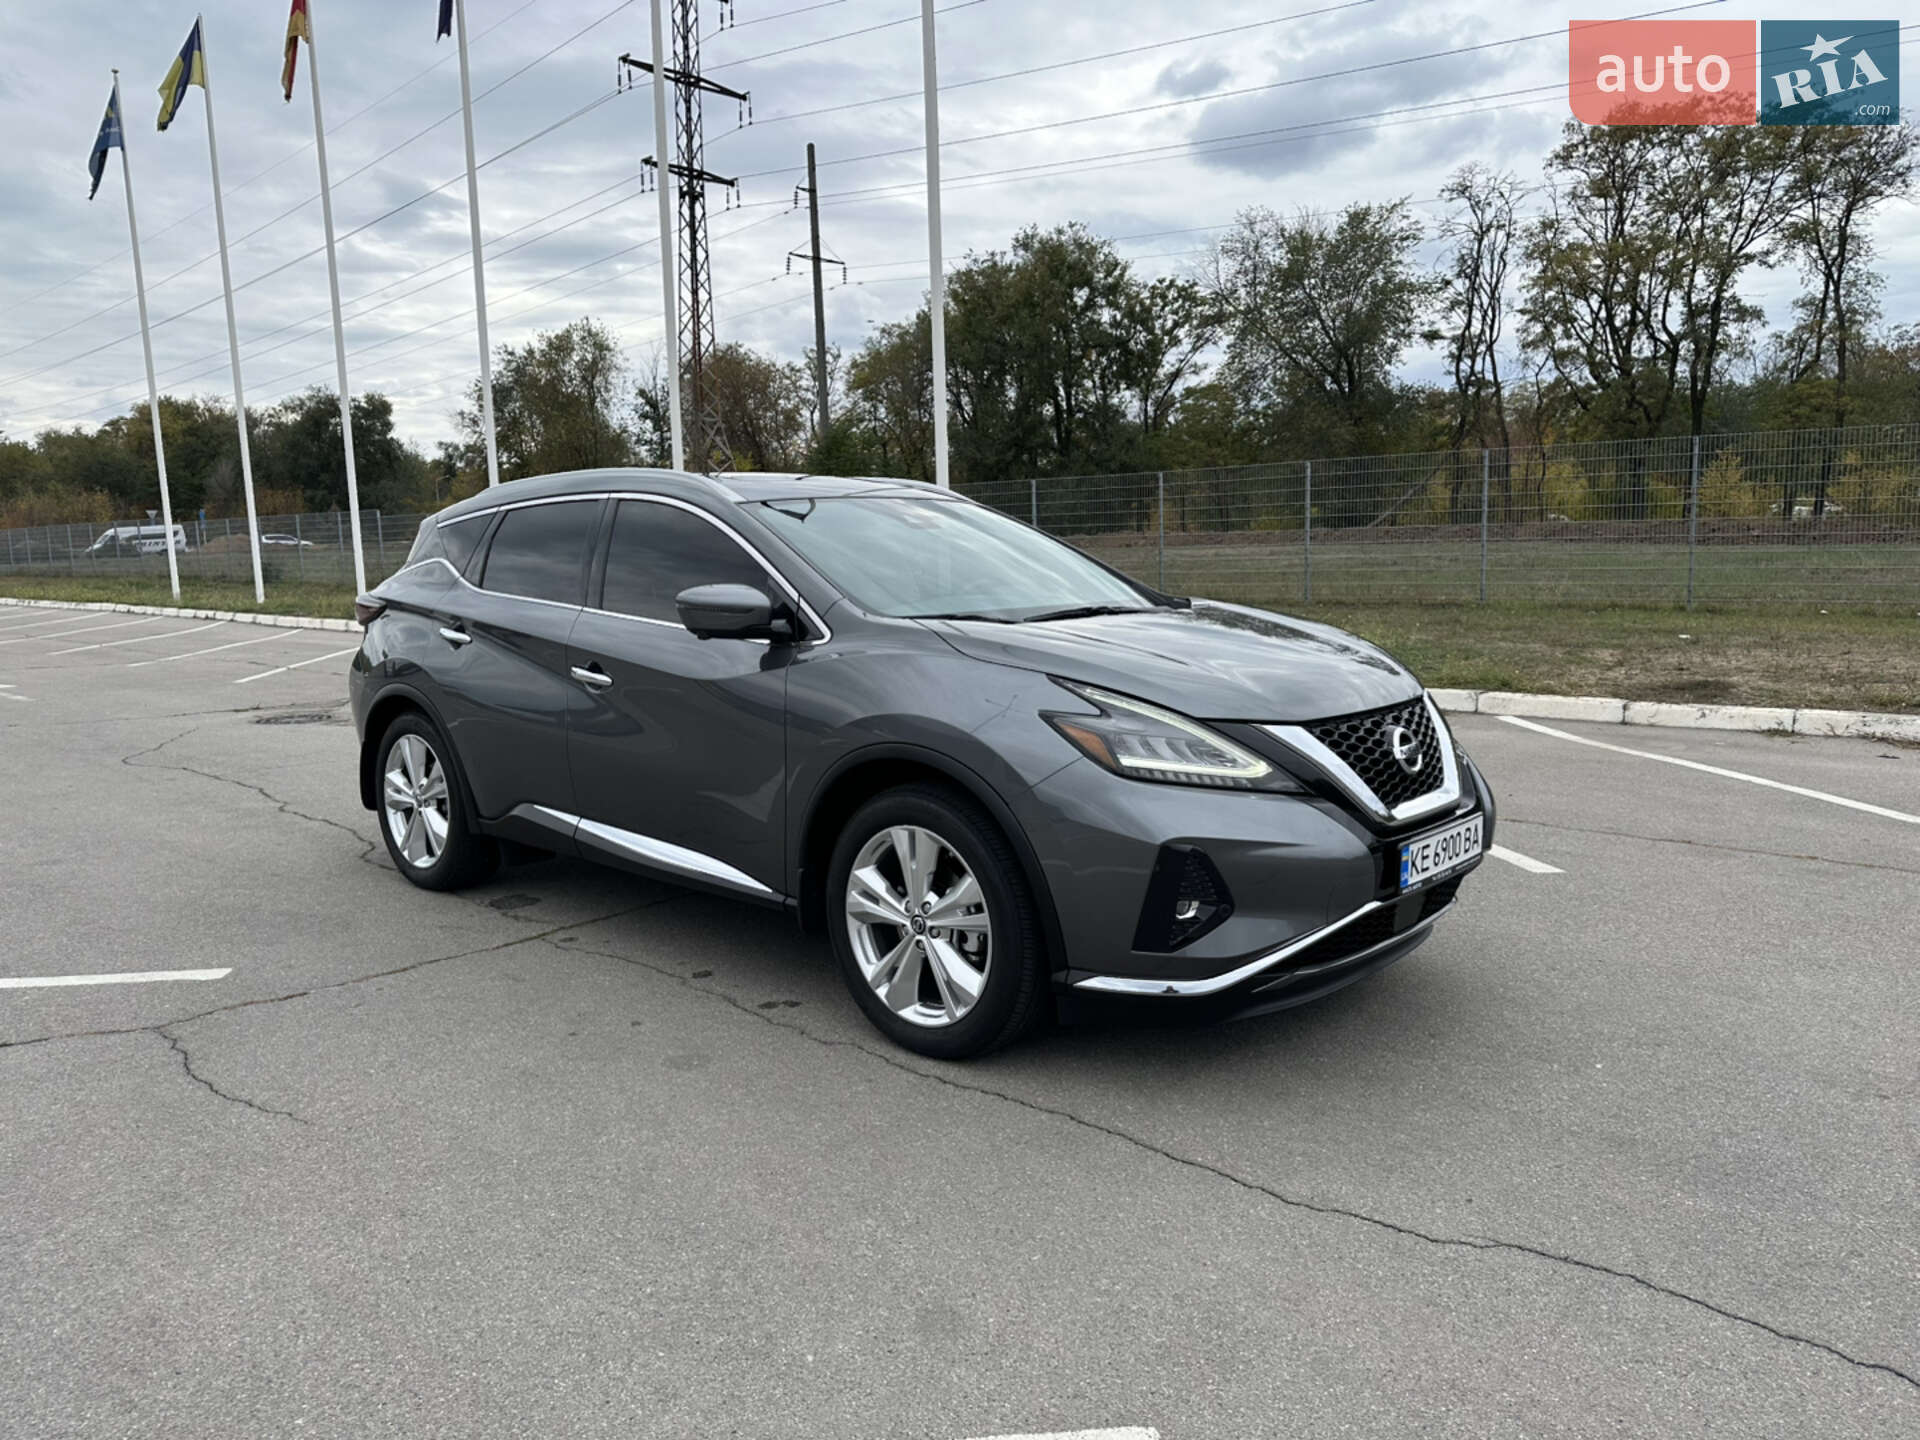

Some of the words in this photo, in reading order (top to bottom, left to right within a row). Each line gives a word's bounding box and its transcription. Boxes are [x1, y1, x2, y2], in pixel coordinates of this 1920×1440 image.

[1410, 844, 1430, 877] KE
[1433, 832, 1461, 866] 6900
[1464, 824, 1479, 853] BA
